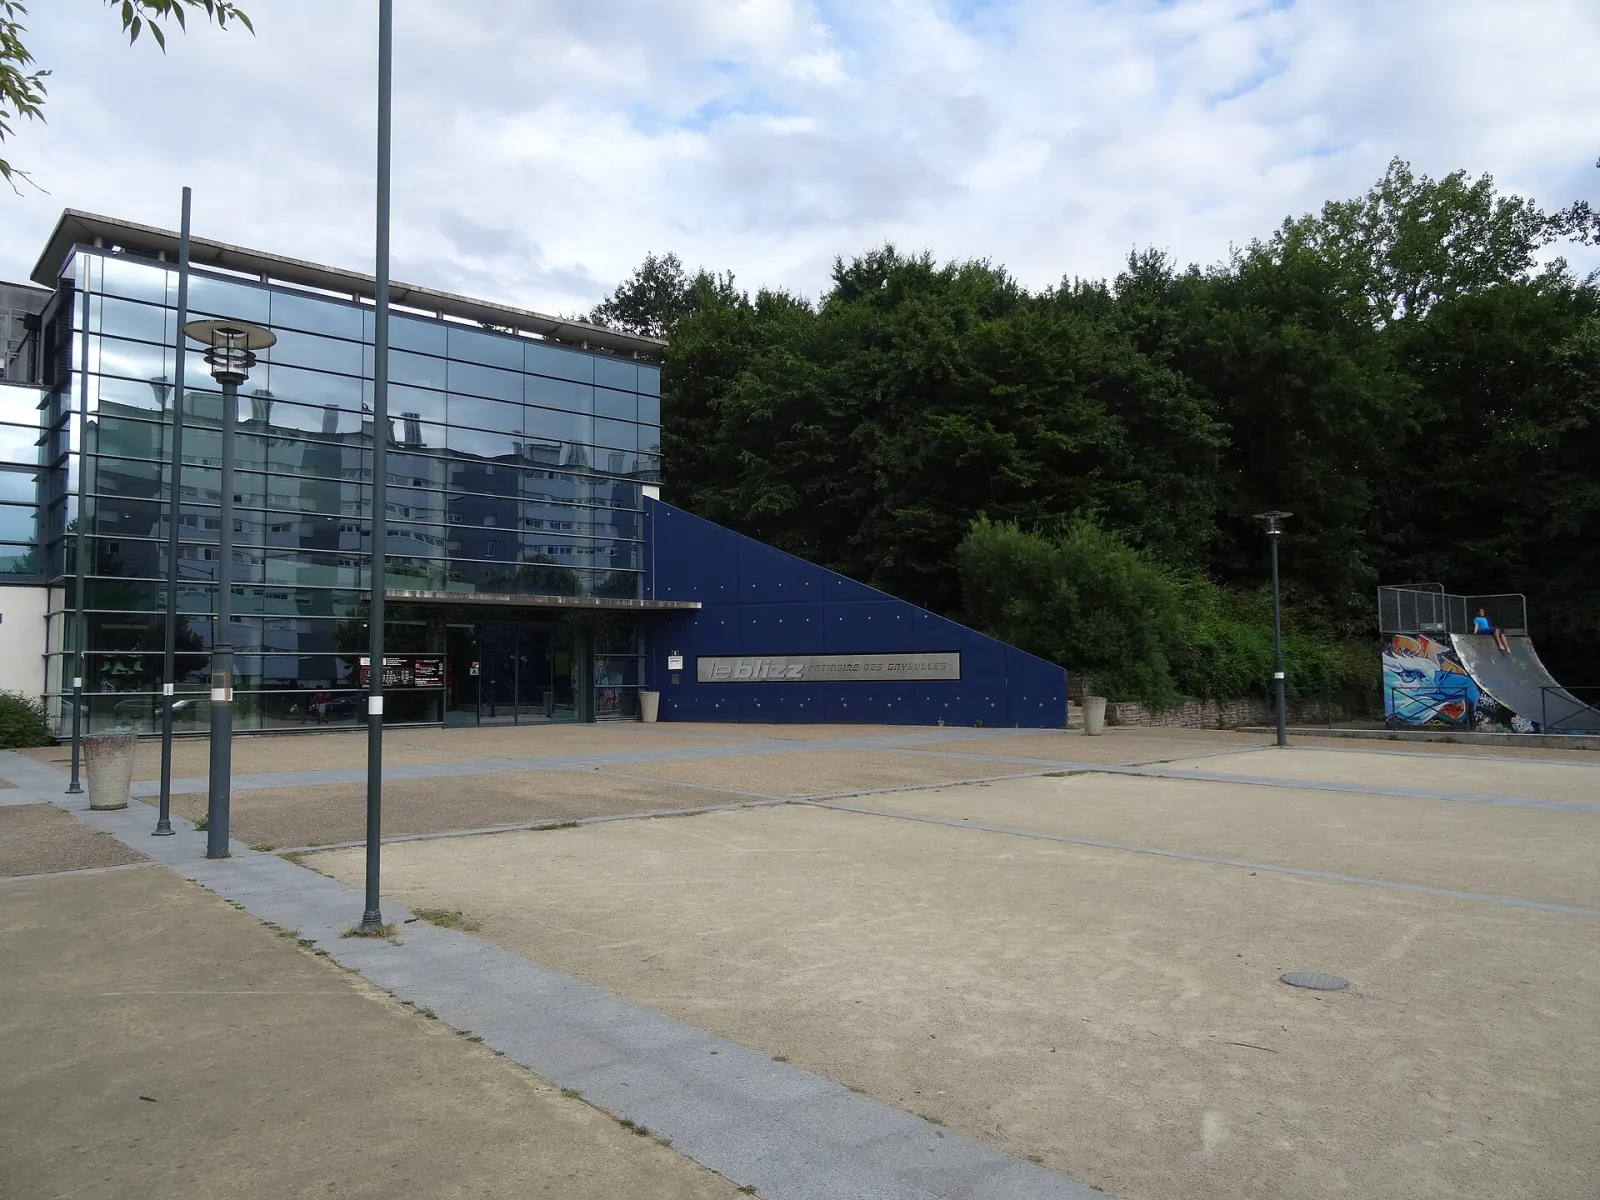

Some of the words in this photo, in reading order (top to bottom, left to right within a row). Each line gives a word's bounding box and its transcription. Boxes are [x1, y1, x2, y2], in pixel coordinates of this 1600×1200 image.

[808, 663, 860, 672] PATINOIRE
[864, 663, 884, 671] DES
[887, 662, 948, 671] GAYEULLES
